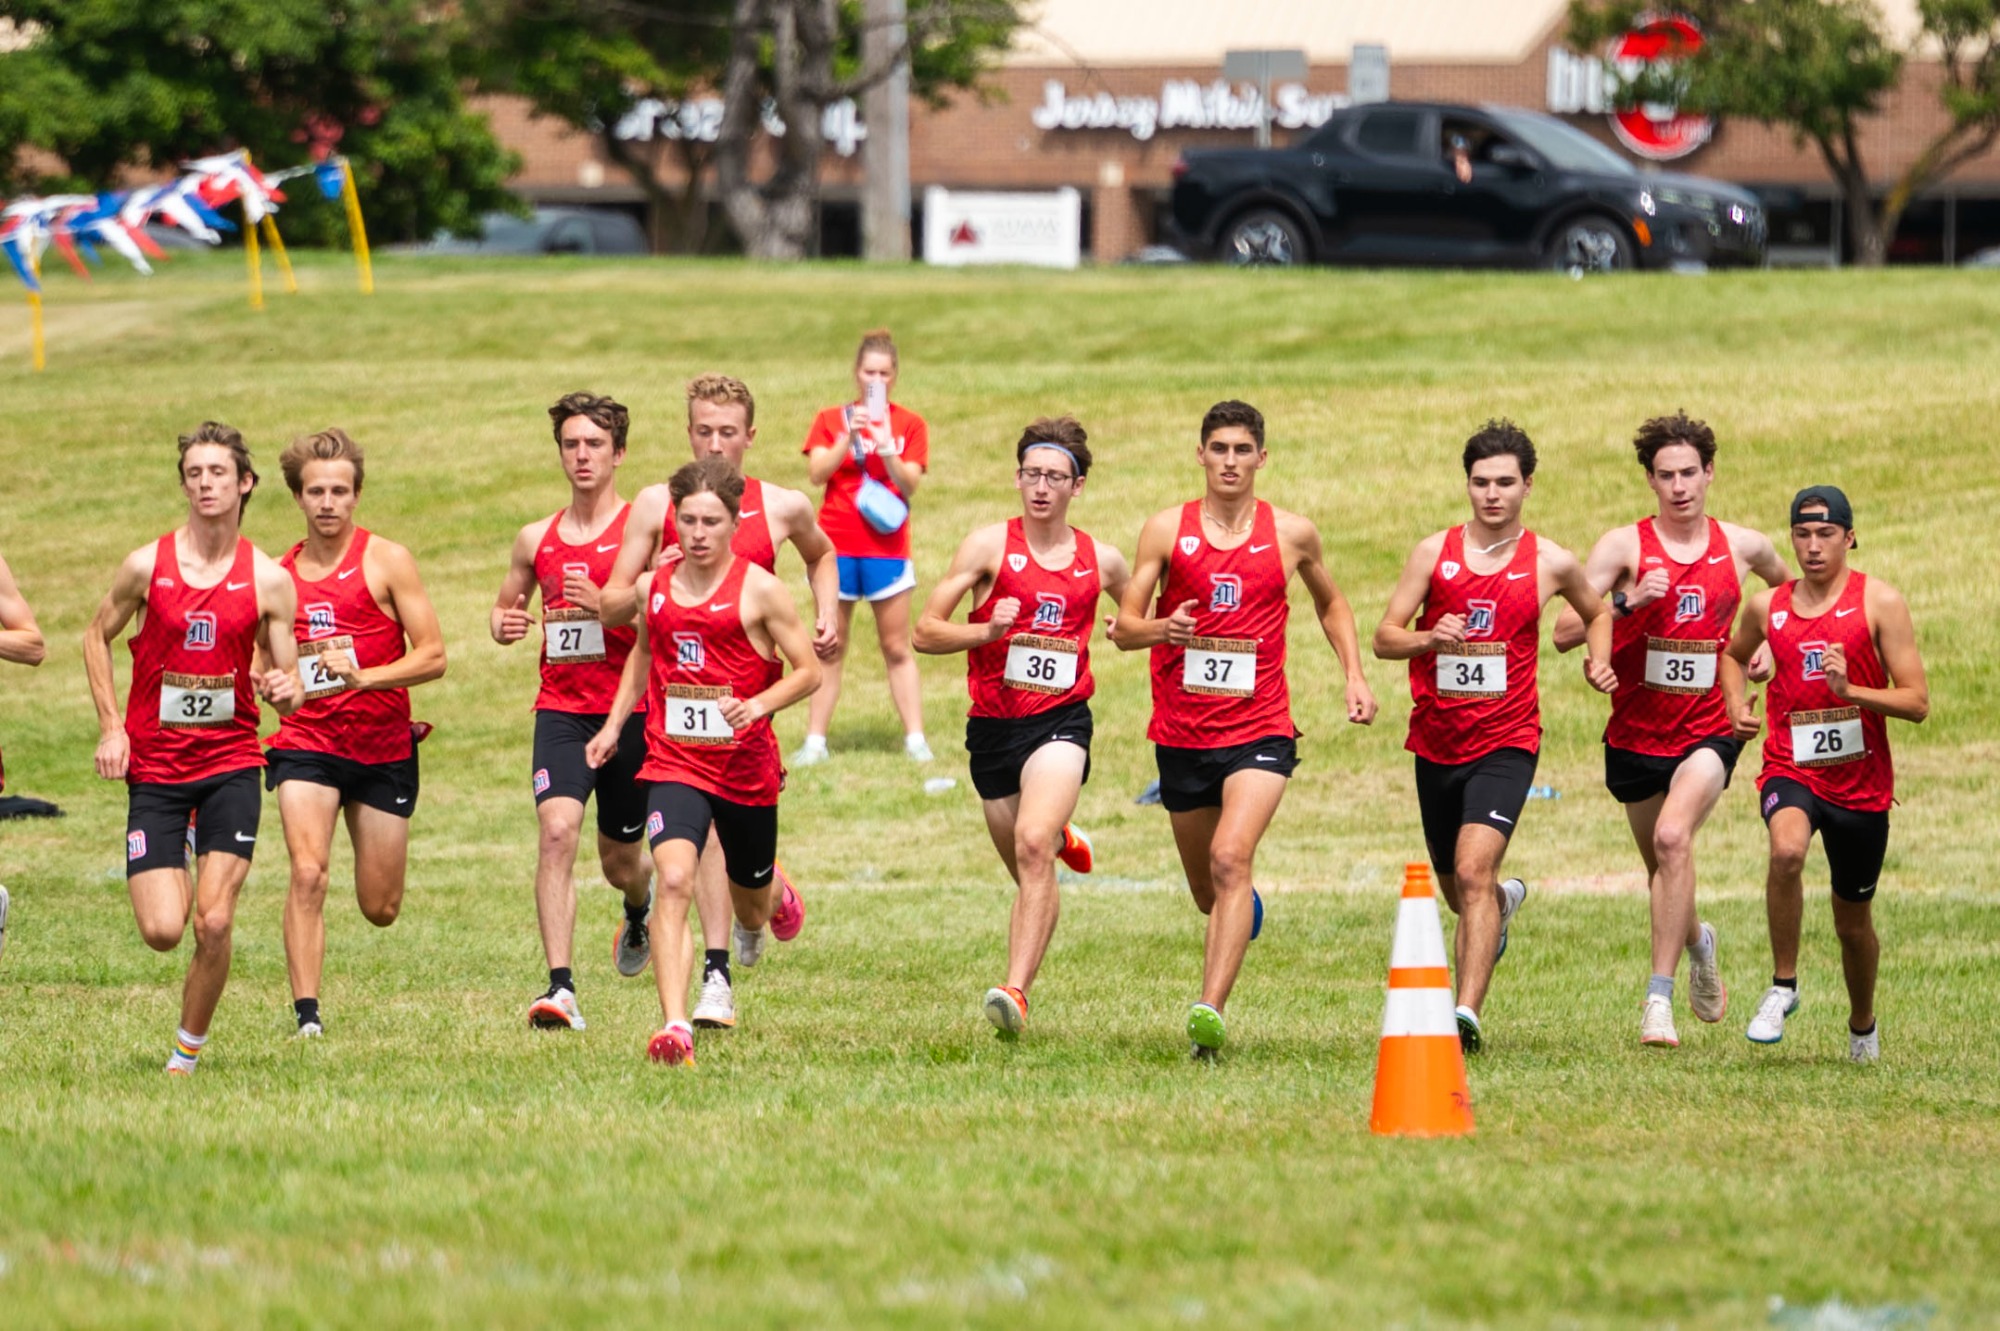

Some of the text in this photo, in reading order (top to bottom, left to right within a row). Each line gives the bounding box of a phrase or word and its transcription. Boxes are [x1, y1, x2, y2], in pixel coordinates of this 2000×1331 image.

[559, 627, 582, 650] 27
[1026, 655, 1057, 680] 36
[1204, 658, 1233, 682] 37
[1456, 662, 1485, 686] 34
[1666, 658, 1695, 683] 35
[182, 695, 212, 717] 32
[684, 706, 707, 731] 31
[1813, 729, 1842, 753] 26
